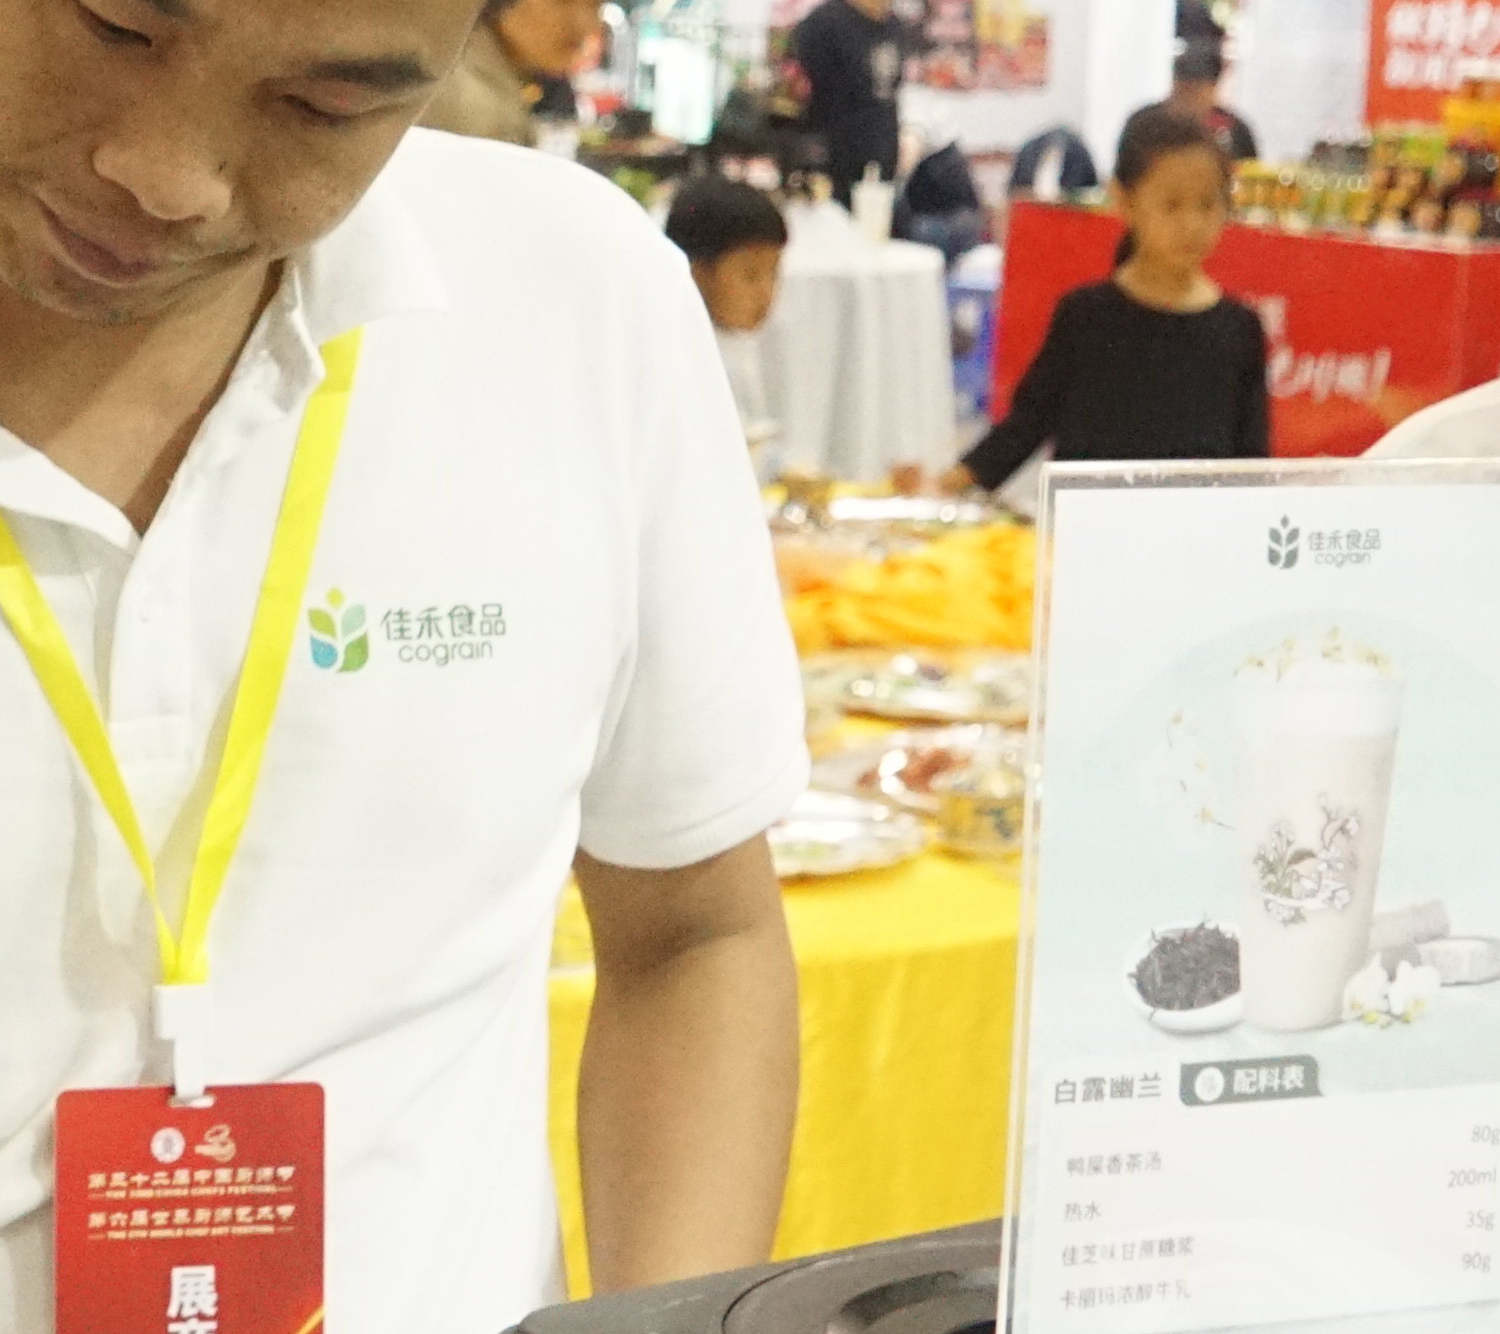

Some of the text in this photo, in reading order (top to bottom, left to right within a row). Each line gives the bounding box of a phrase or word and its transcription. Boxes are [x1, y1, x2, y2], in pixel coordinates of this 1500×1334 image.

[1307, 528, 1381, 551] 佳禾食品
[380, 603, 506, 641] 佳禾食品
[398, 640, 493, 667] cograin
[1054, 1072, 1162, 1105] 白露幽兰
[1232, 1065, 1305, 1096] 配料表
[1471, 1125, 1500, 1146] 80g
[1063, 1167, 1497, 1223] 热水 200ml
[1466, 1210, 1495, 1231] 35g
[1461, 1251, 1491, 1273] 90g
